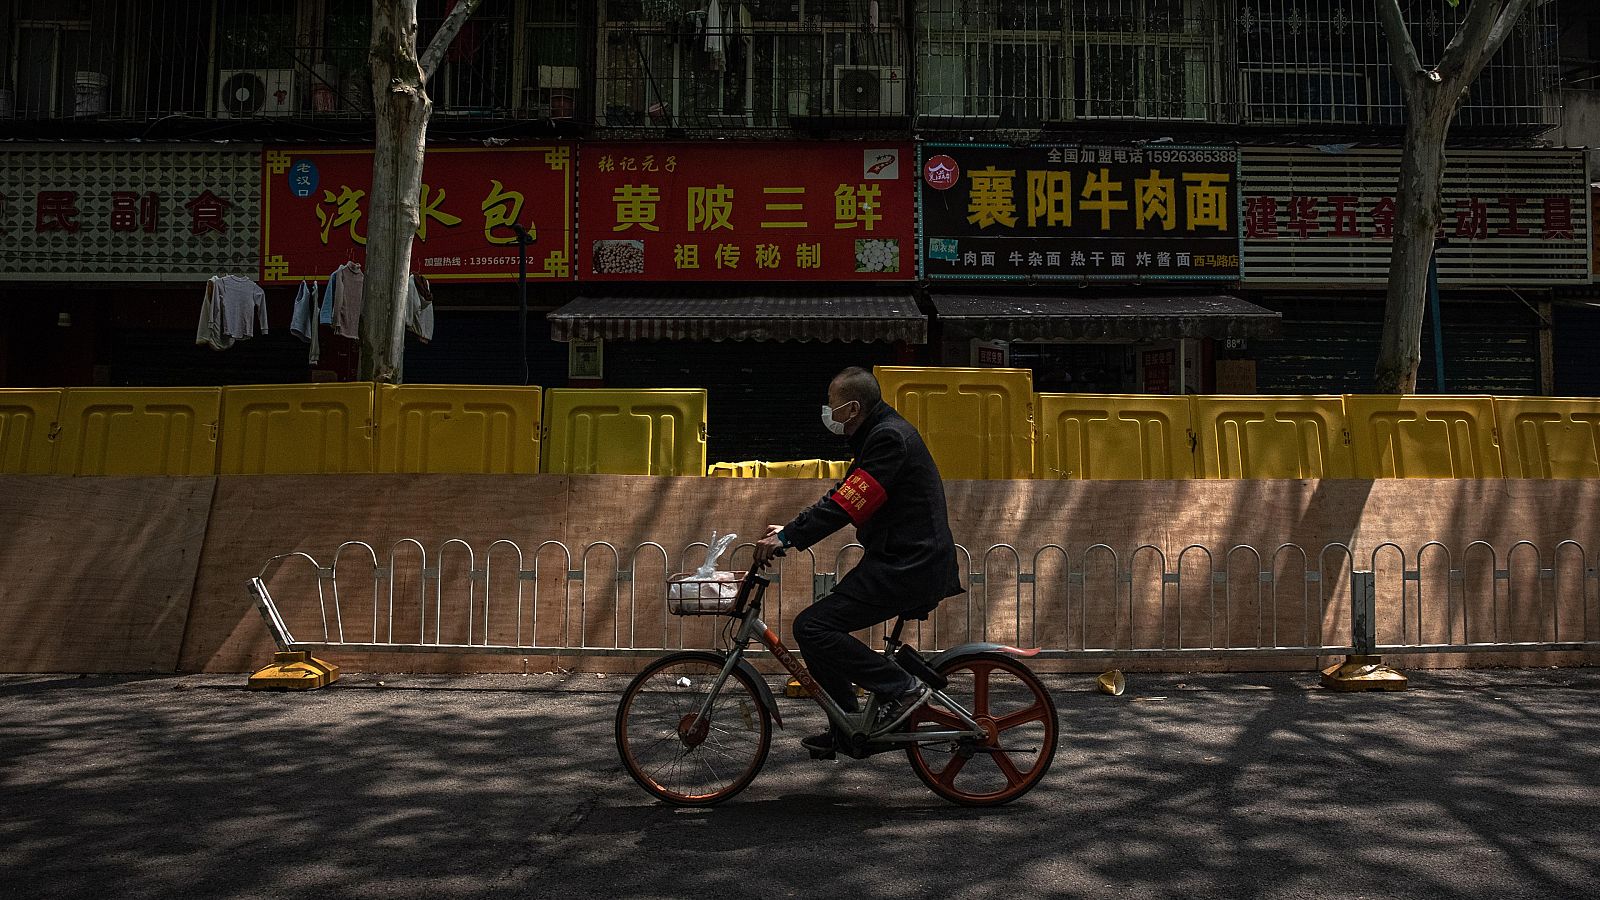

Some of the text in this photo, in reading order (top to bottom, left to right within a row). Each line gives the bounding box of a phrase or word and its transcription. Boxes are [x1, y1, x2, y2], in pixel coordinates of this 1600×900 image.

[1047, 148, 1237, 164] 全国加盟电话 15926365388
[296, 163, 311, 197] 老汉口
[966, 165, 1231, 232] 襄阳牛肉面
[0, 189, 231, 236] 民副食
[315, 179, 537, 246] 汽水包
[612, 183, 883, 232] 黄陂三鲜
[1245, 194, 1574, 239] 建华五金动工具
[674, 243, 821, 269] 祖传秘制
[1009, 251, 1061, 267] 牛杂面
[1070, 251, 1126, 267] 热干面
[1135, 251, 1191, 267] 炸酱面
[1192, 254, 1239, 268] 西马路店
